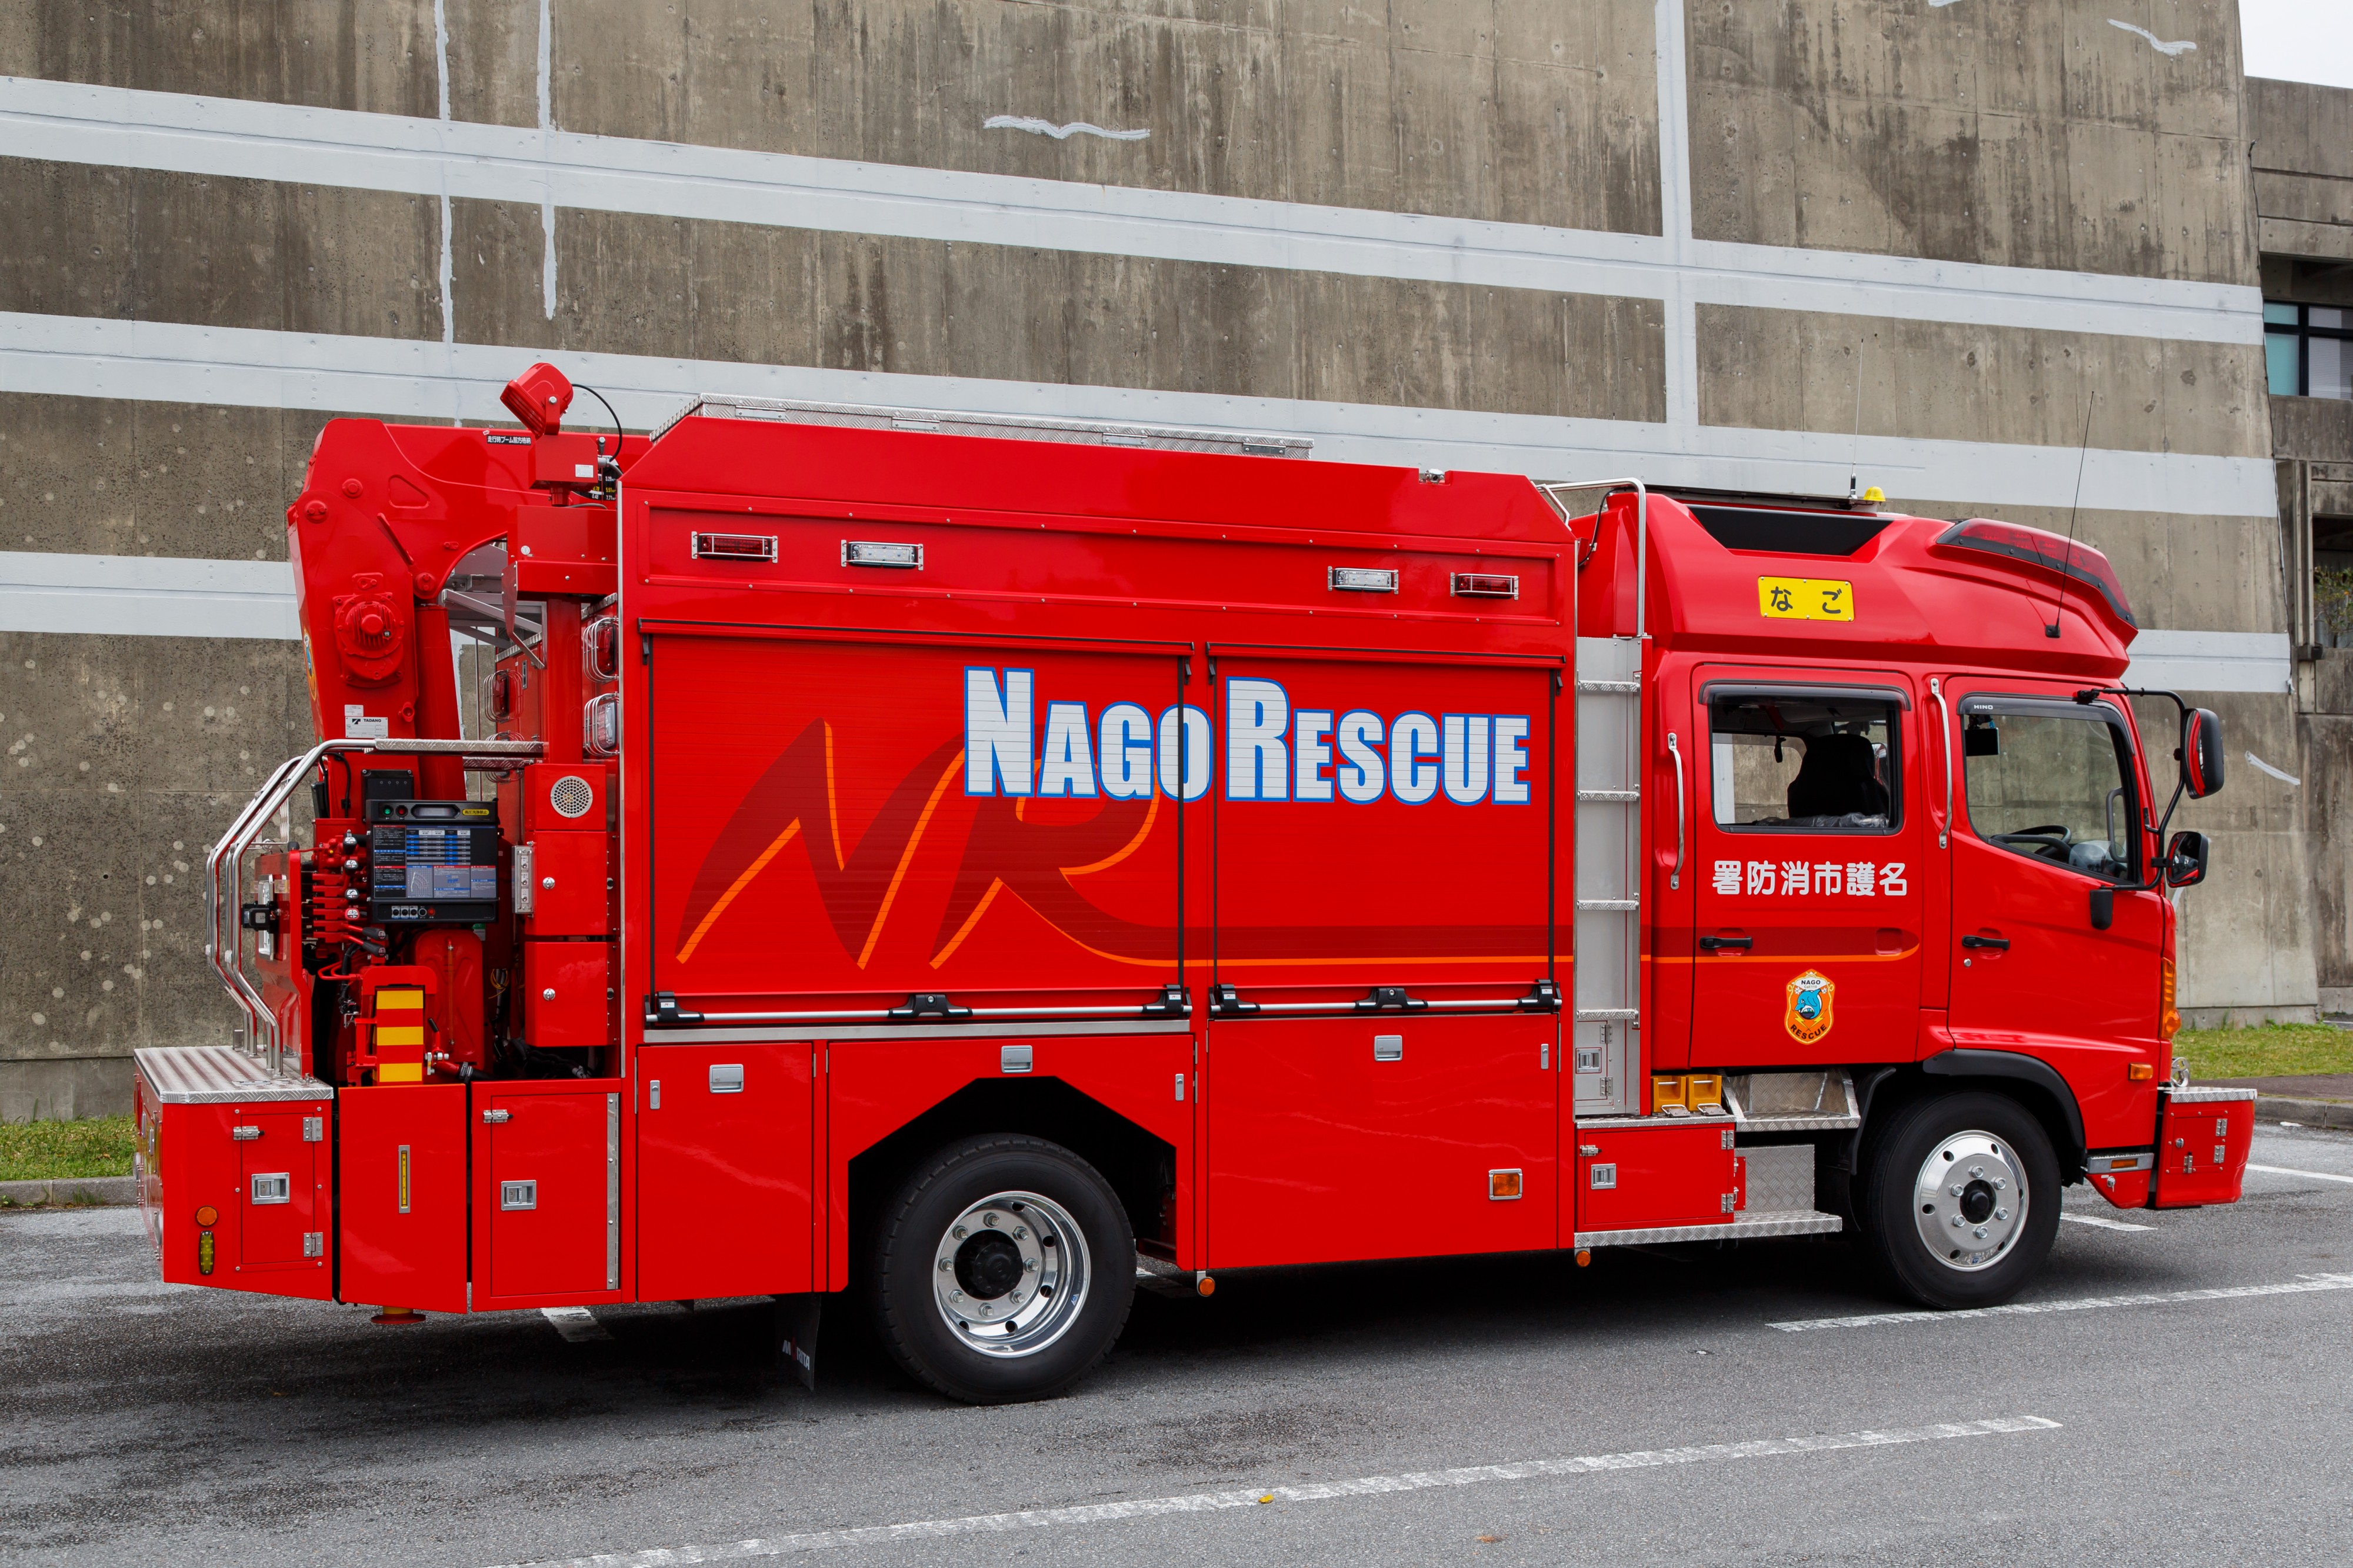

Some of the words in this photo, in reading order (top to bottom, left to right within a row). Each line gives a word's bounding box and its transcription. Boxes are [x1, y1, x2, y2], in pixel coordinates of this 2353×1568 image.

[964, 666, 1212, 802] NAGO
[1225, 676, 1531, 806] RESCUE
[1791, 1024, 1827, 1039] RESCUE
